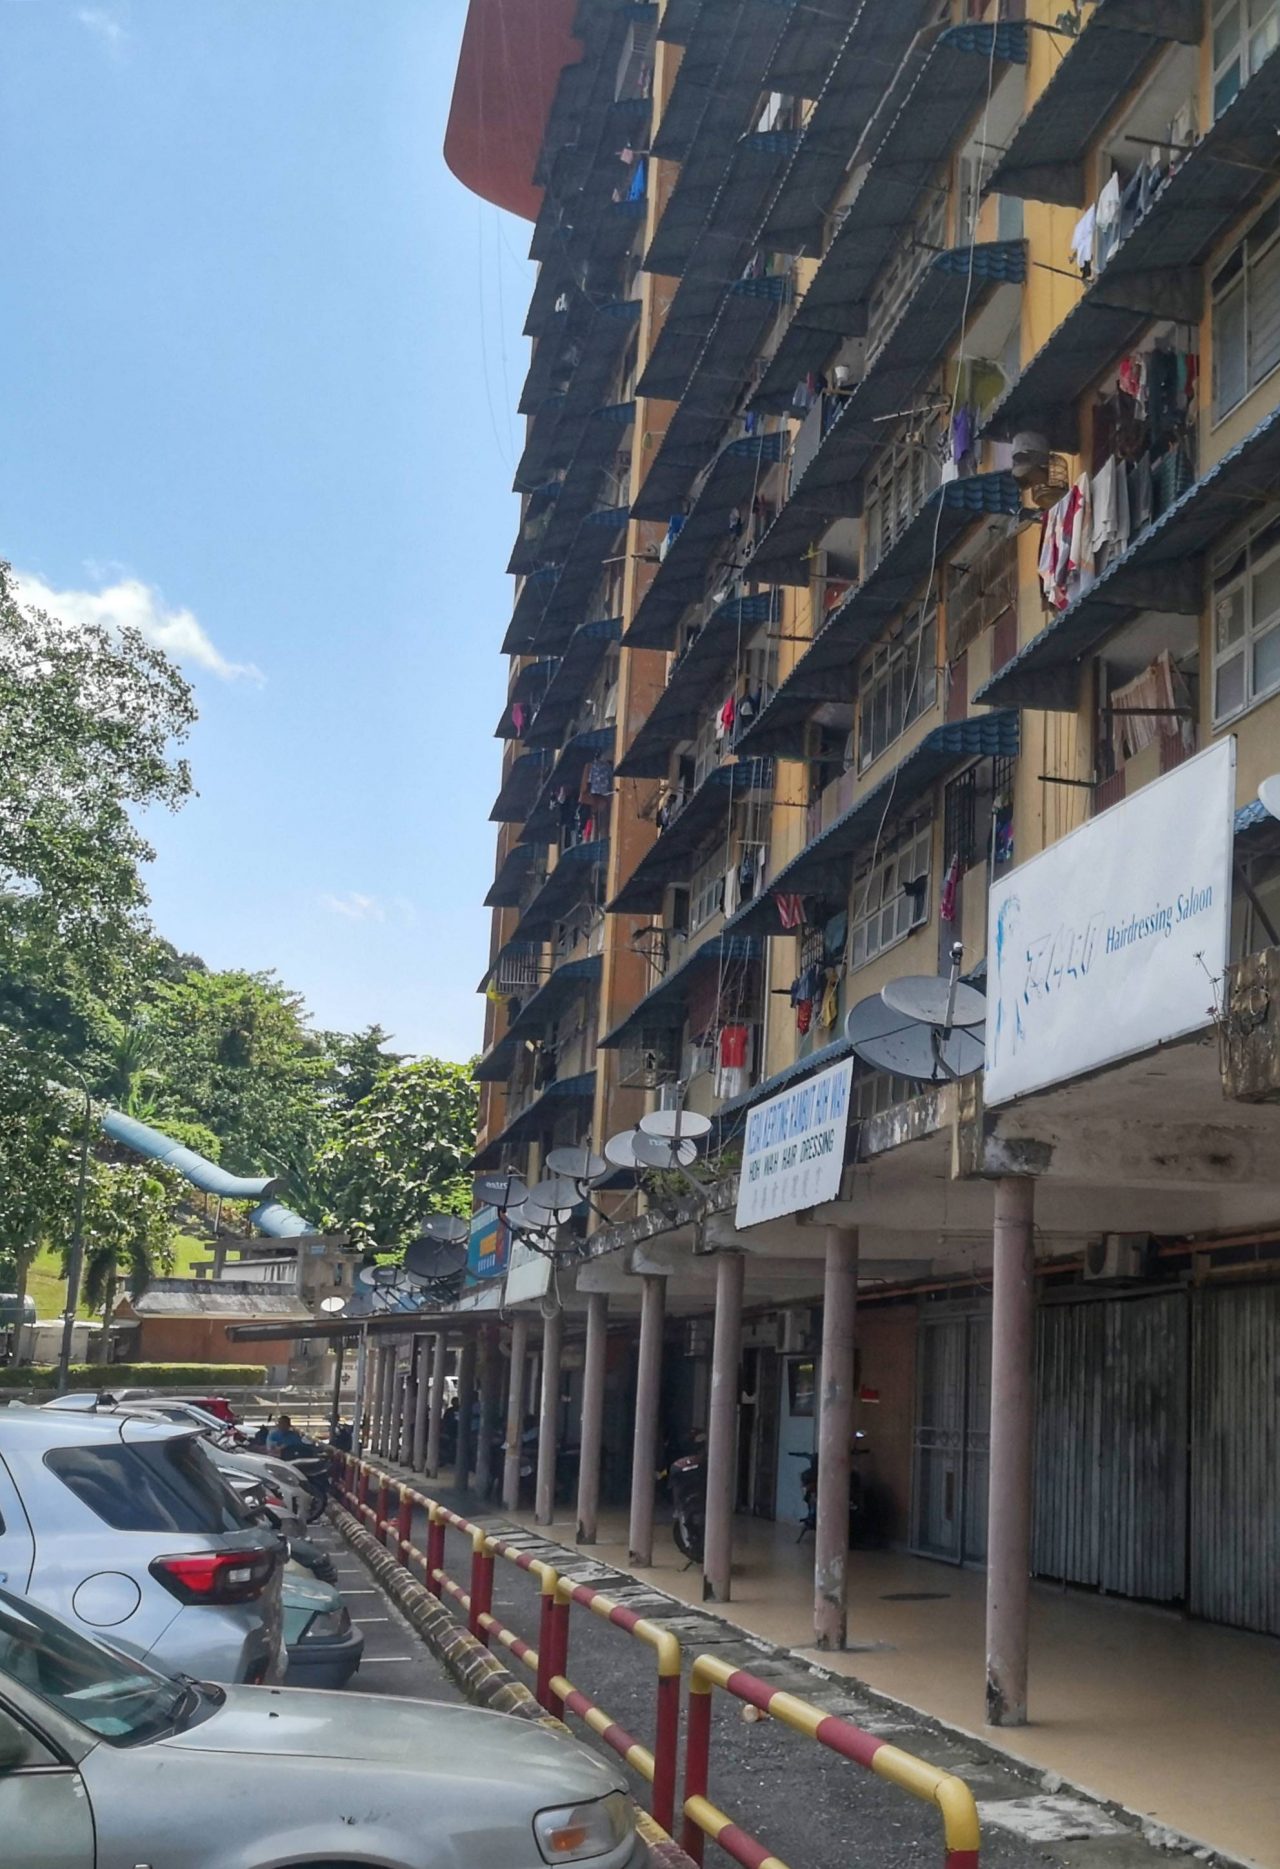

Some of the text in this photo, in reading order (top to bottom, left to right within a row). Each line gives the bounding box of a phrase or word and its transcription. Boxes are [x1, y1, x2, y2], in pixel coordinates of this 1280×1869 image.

[1105, 886, 1213, 954] Hairdressing Saloon
[749, 1128, 835, 1183] HOH WAH HAIR DRESSING
